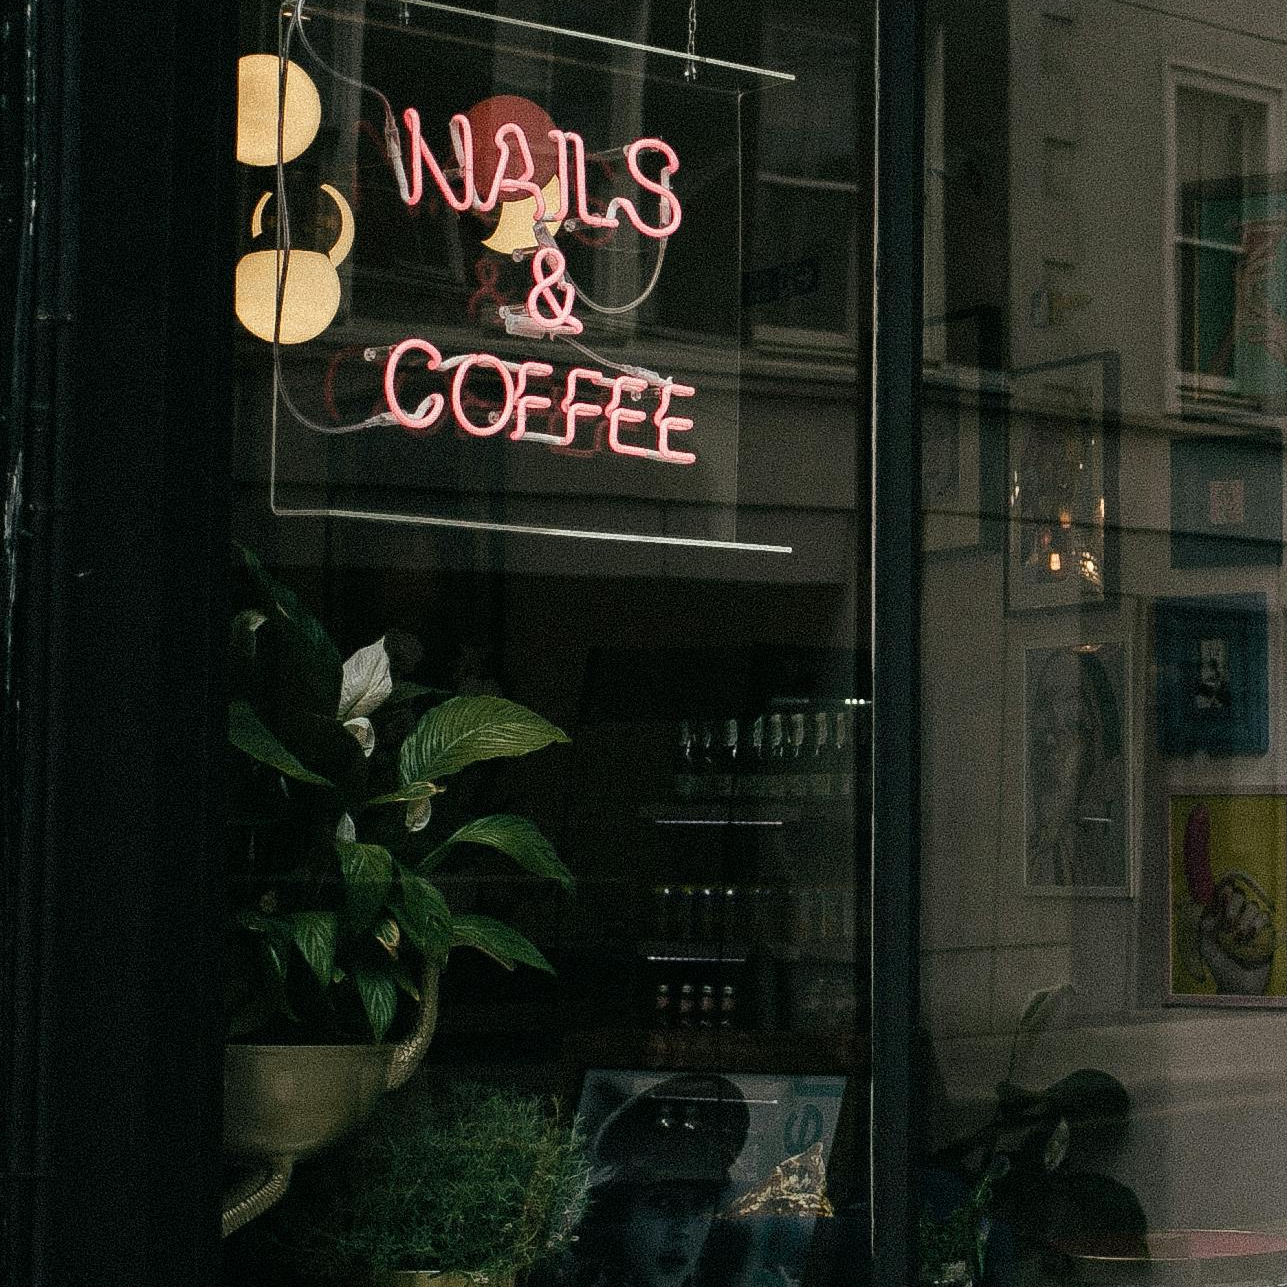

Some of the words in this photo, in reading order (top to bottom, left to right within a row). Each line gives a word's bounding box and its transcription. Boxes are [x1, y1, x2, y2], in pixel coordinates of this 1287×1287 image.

[392, 106, 682, 238] NAILS
[528, 247, 584, 335] &
[384, 338, 696, 464] COFFEE
